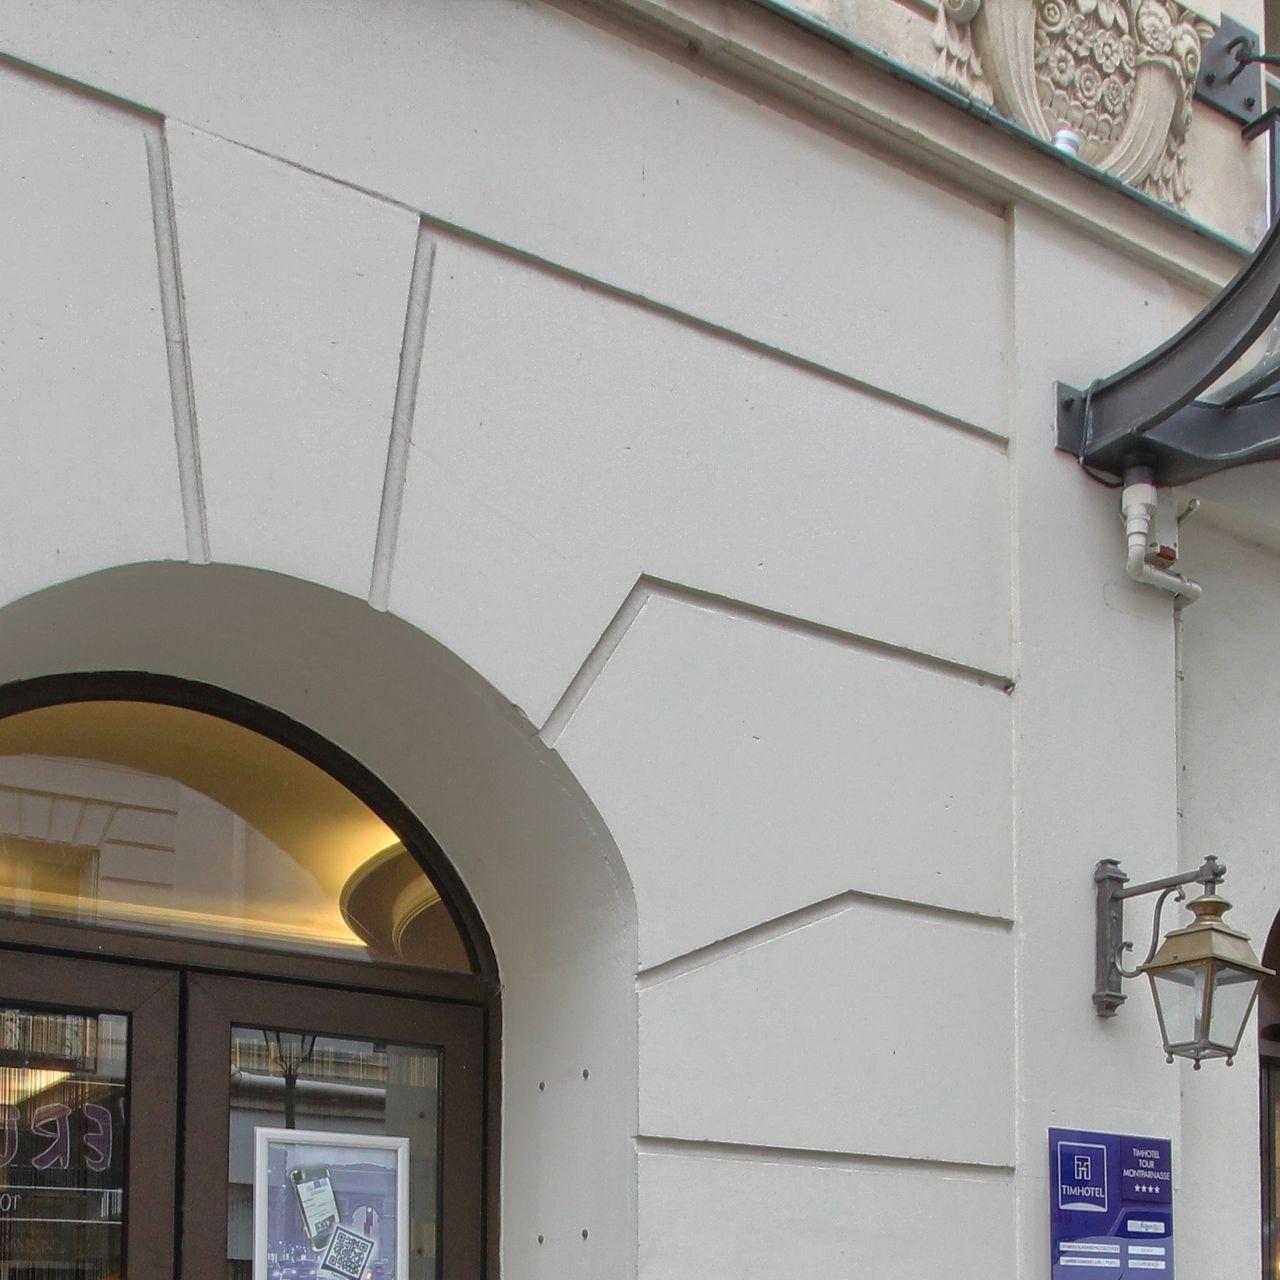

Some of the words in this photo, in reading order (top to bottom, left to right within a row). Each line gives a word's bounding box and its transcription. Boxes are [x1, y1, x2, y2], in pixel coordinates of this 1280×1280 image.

[1133, 1148, 1161, 1160] TIMHOTEL
[1138, 1159, 1155, 1169] TOUR
[1122, 1168, 1171, 1181] MONTPARNASSE
[1061, 1184, 1106, 1198] TIMHOTEL
